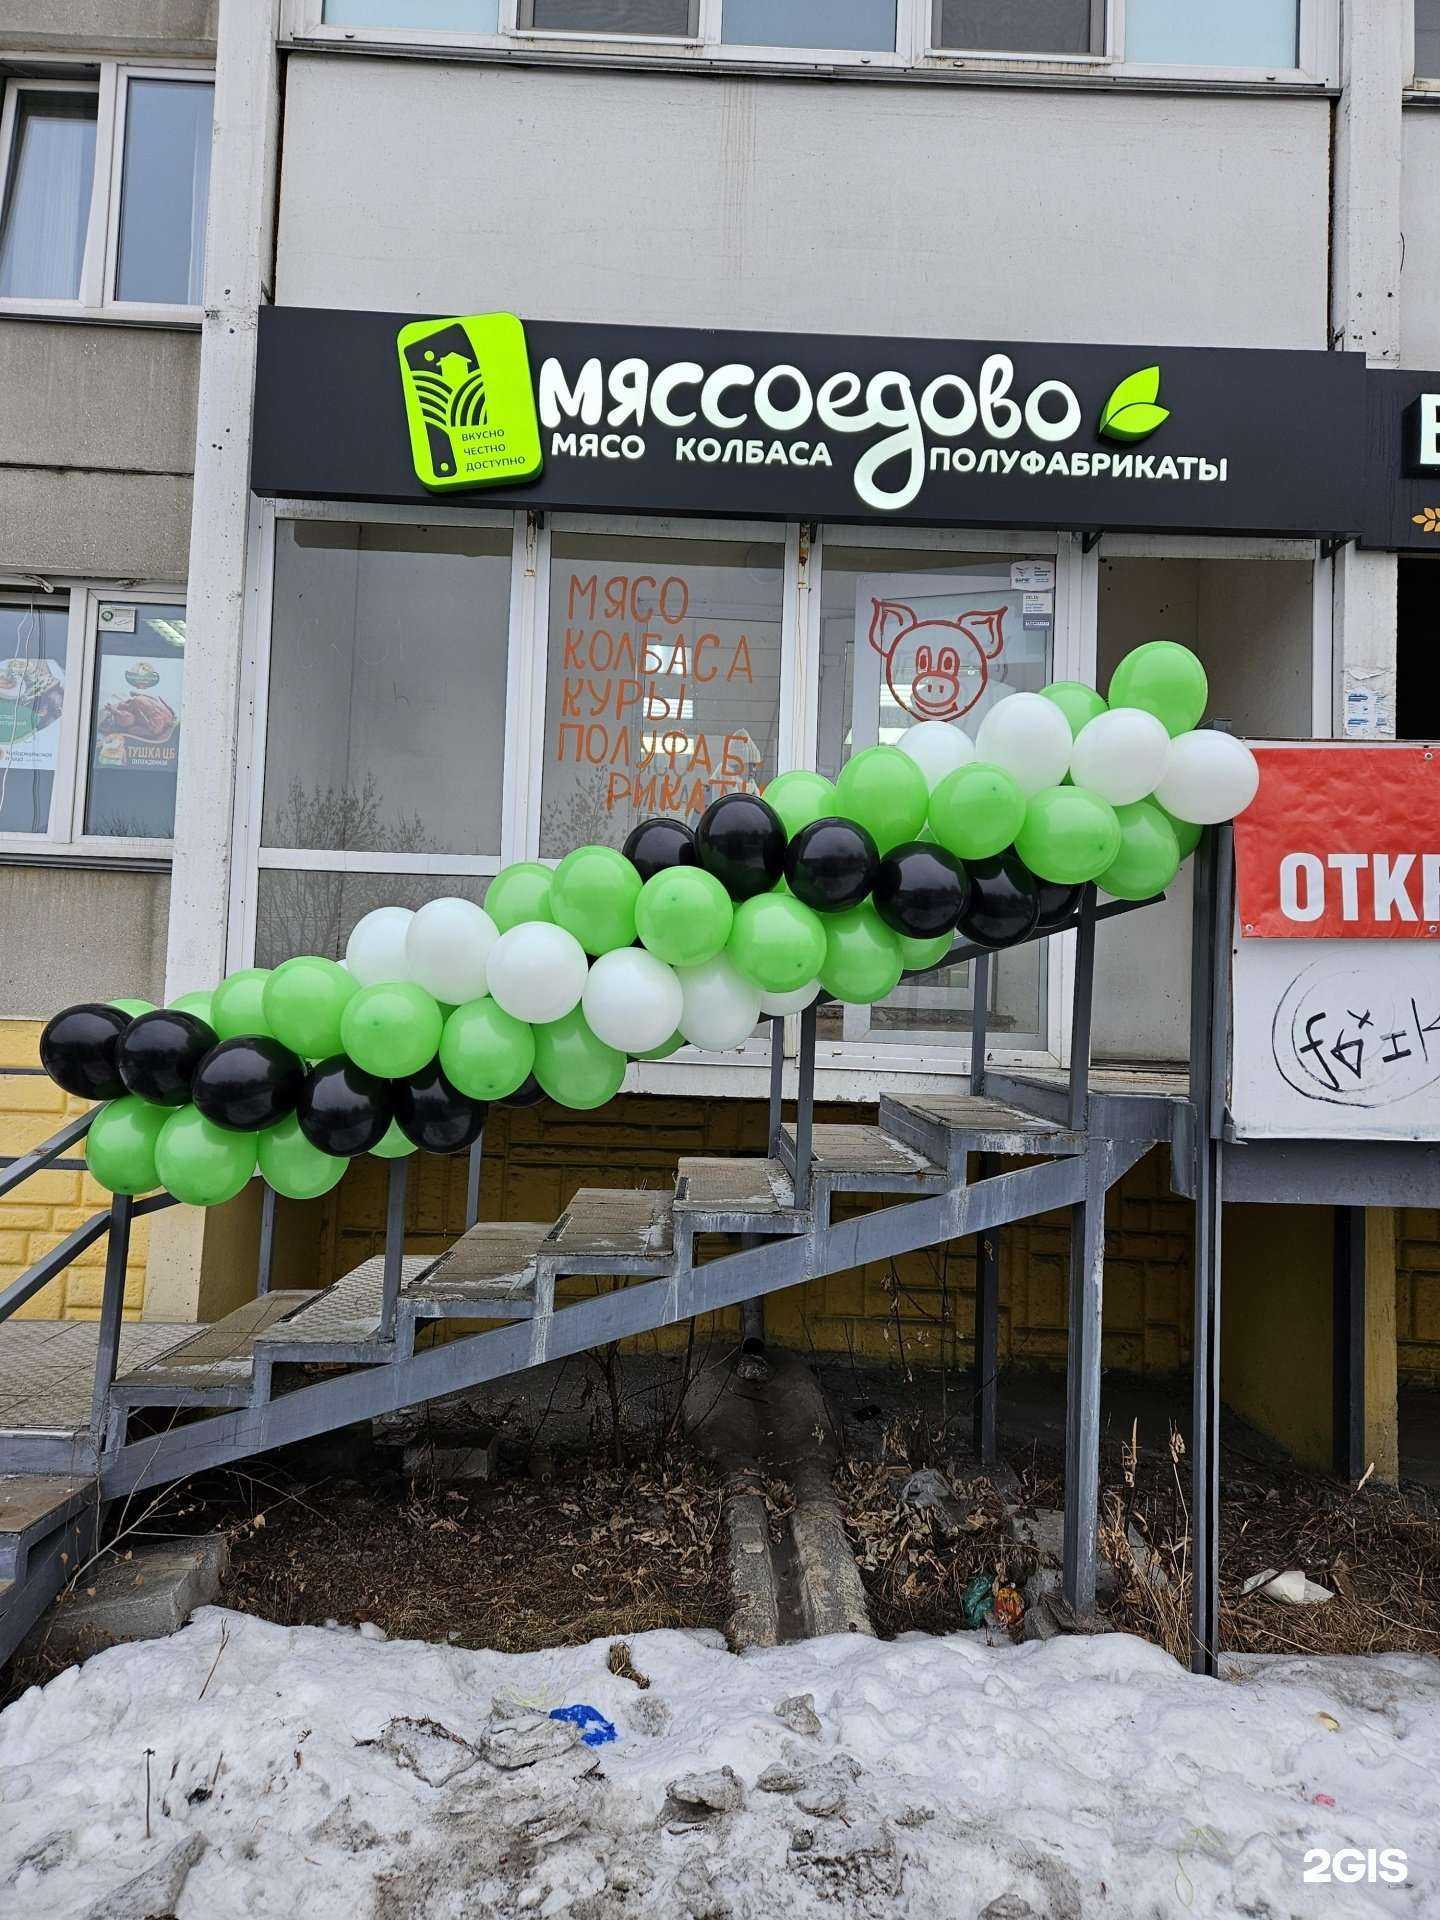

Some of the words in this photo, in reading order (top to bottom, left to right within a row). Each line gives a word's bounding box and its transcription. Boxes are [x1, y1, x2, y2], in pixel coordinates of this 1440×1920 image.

[461, 428, 505, 442] ВКУСНО
[463, 443, 506, 456] ЧЕСТНО
[466, 456, 526, 473] ДОСТУПНО
[551, 432, 646, 460] МЯСО
[675, 436, 833, 467] КОЛБАСА
[929, 446, 1229, 483] ПОЛУФАБРИКАТЫ
[567, 574, 690, 625] МЯСО
[562, 627, 753, 685] КОЛБАСА
[561, 677, 687, 721] КУРЫ
